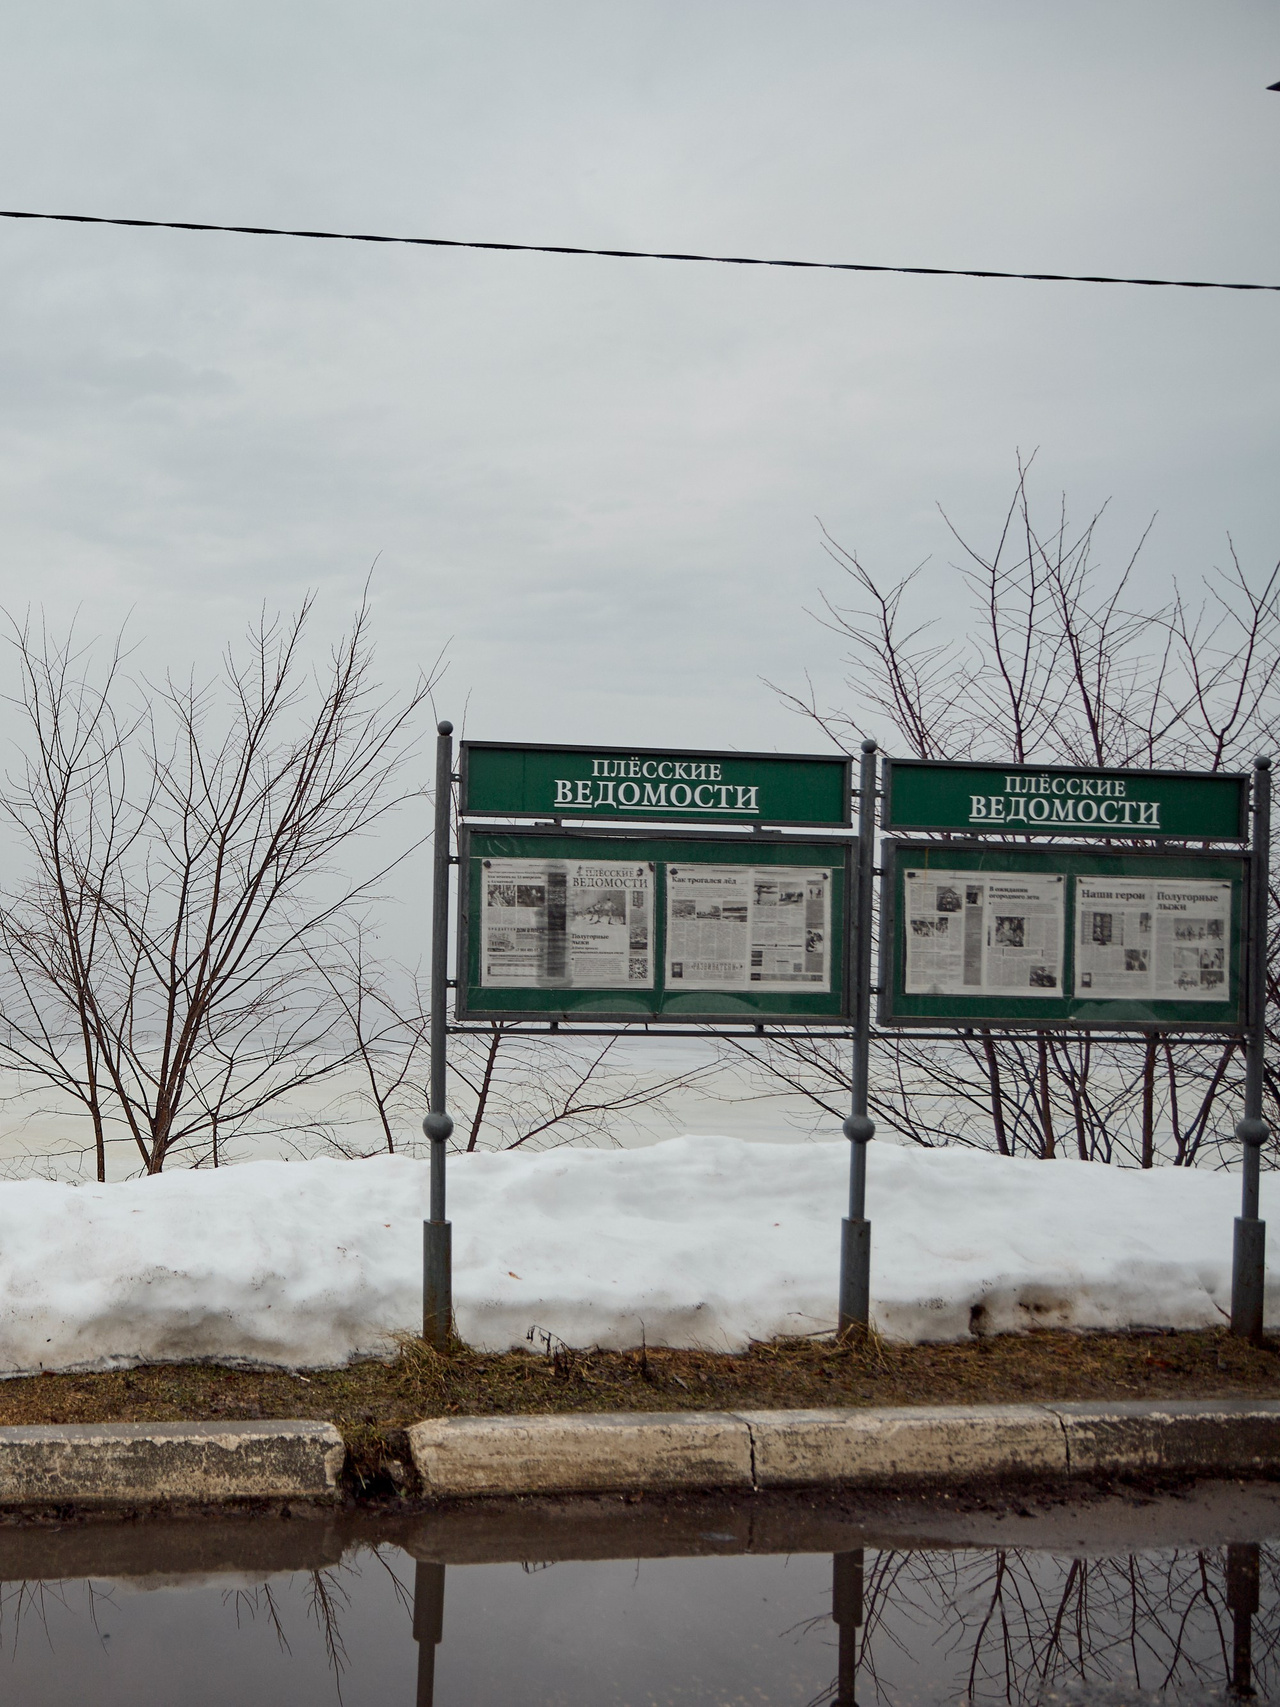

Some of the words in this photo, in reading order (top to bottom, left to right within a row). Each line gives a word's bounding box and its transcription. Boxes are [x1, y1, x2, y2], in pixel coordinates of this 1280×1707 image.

[591, 757, 722, 780] ПЛЁССКИЕ
[1004, 773, 1126, 797] ПЛЁССКИЕ
[554, 779, 759, 810] ВЕДОМОСТИ
[969, 795, 1160, 825] ВЕДОМОСТИ
[585, 867, 635, 878] ПЛЁССКИЕ
[572, 876, 649, 888] ВЕДОМОСТИ
[1081, 889, 1113, 899] Наши
[1115, 891, 1146, 901] герои
[1156, 891, 1219, 903] Полугорные
[1156, 903, 1187, 911] лыжи
